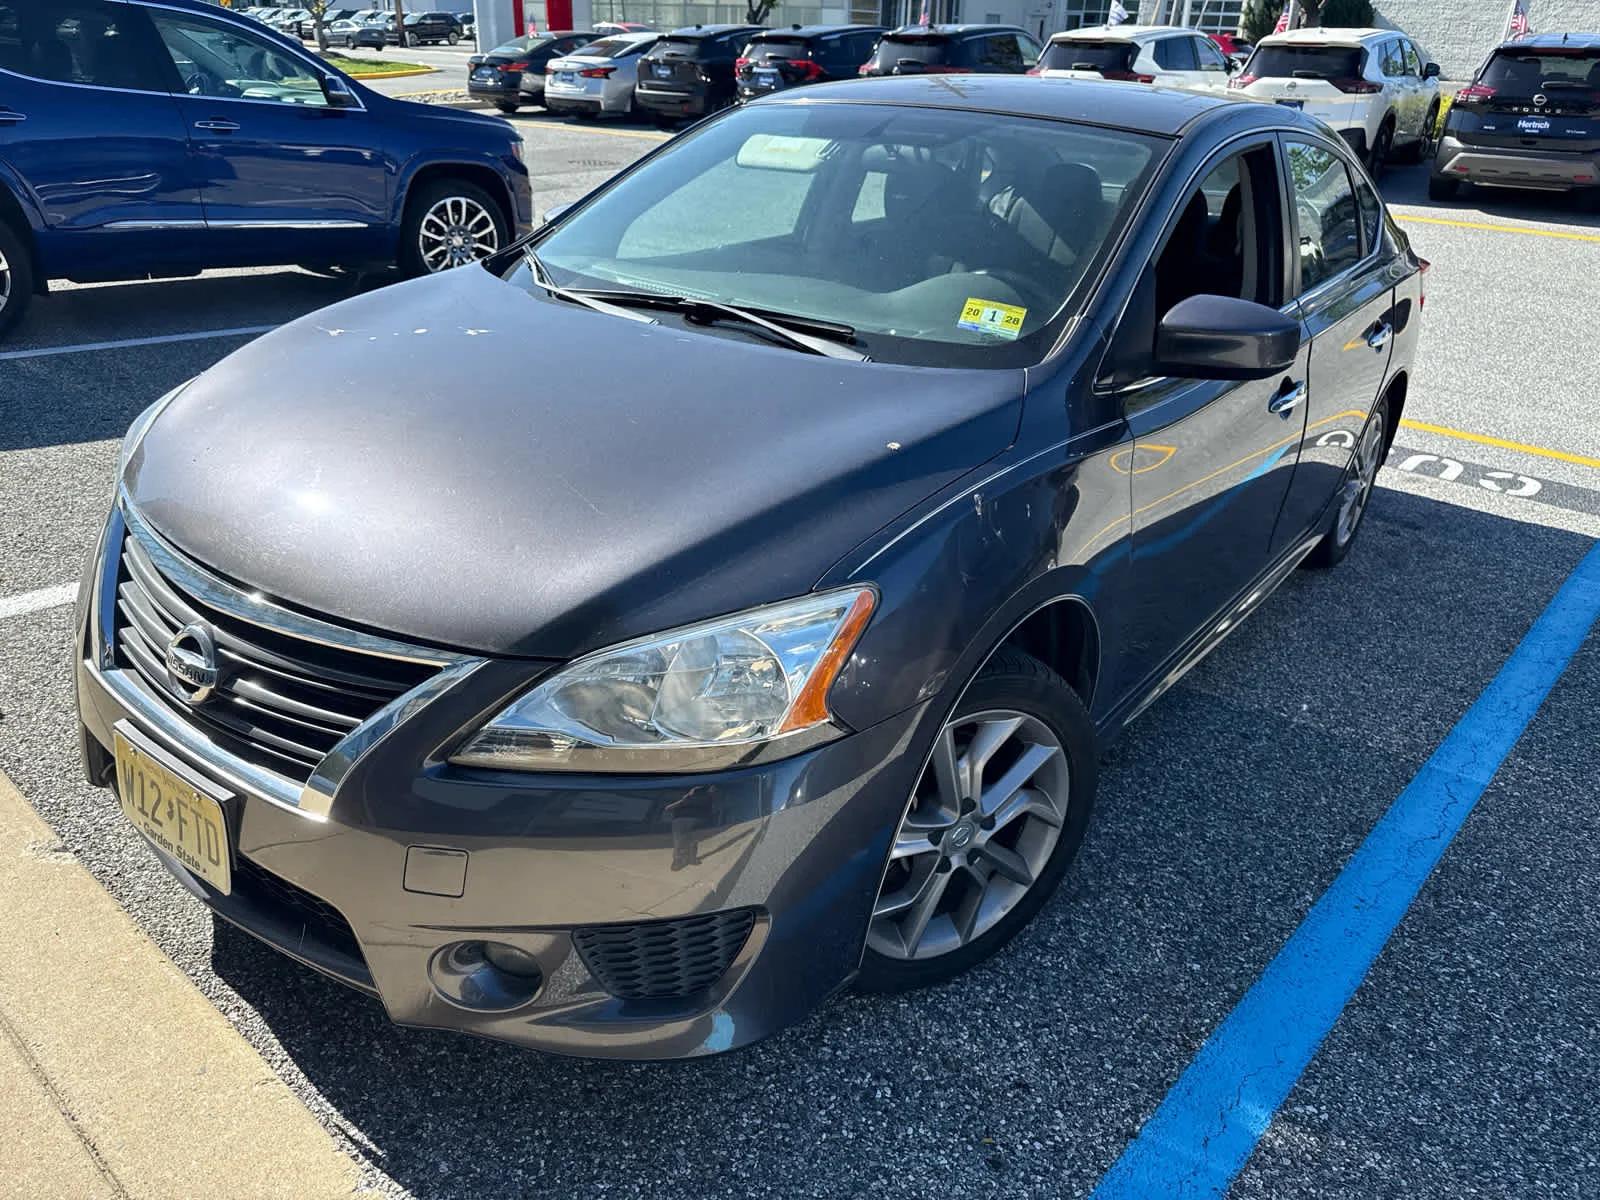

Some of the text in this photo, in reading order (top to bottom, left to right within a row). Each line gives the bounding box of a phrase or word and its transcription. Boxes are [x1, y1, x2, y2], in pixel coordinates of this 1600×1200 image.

[966, 307, 1020, 326] 20 1 28
[167, 651, 207, 684] NISSAN
[143, 822, 202, 871] Garden State
